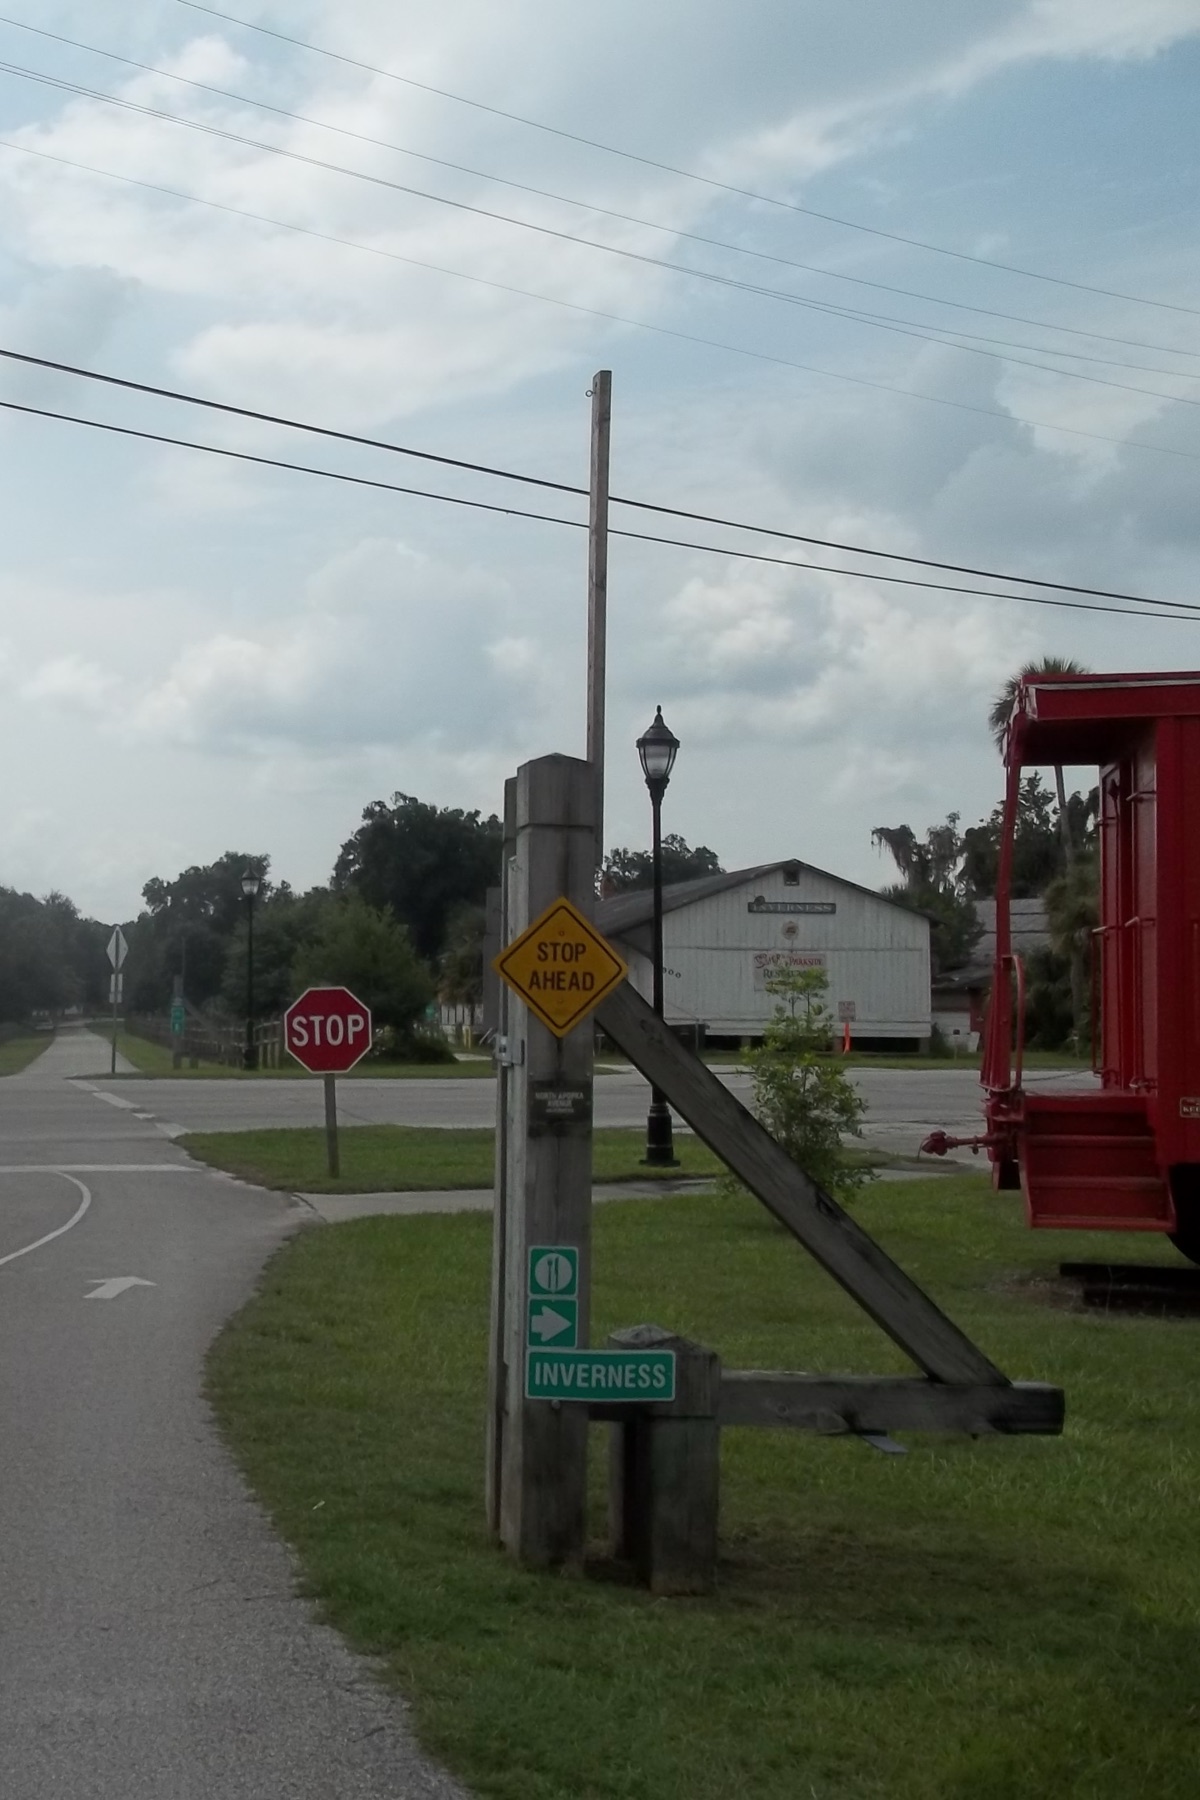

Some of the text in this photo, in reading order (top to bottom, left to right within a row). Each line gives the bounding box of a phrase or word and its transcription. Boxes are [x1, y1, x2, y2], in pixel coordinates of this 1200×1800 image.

[537, 942, 586, 962] STOP
[528, 970, 595, 991] AHEAD
[292, 1014, 364, 1046] STOP
[535, 1362, 666, 1388] INVERNESS
